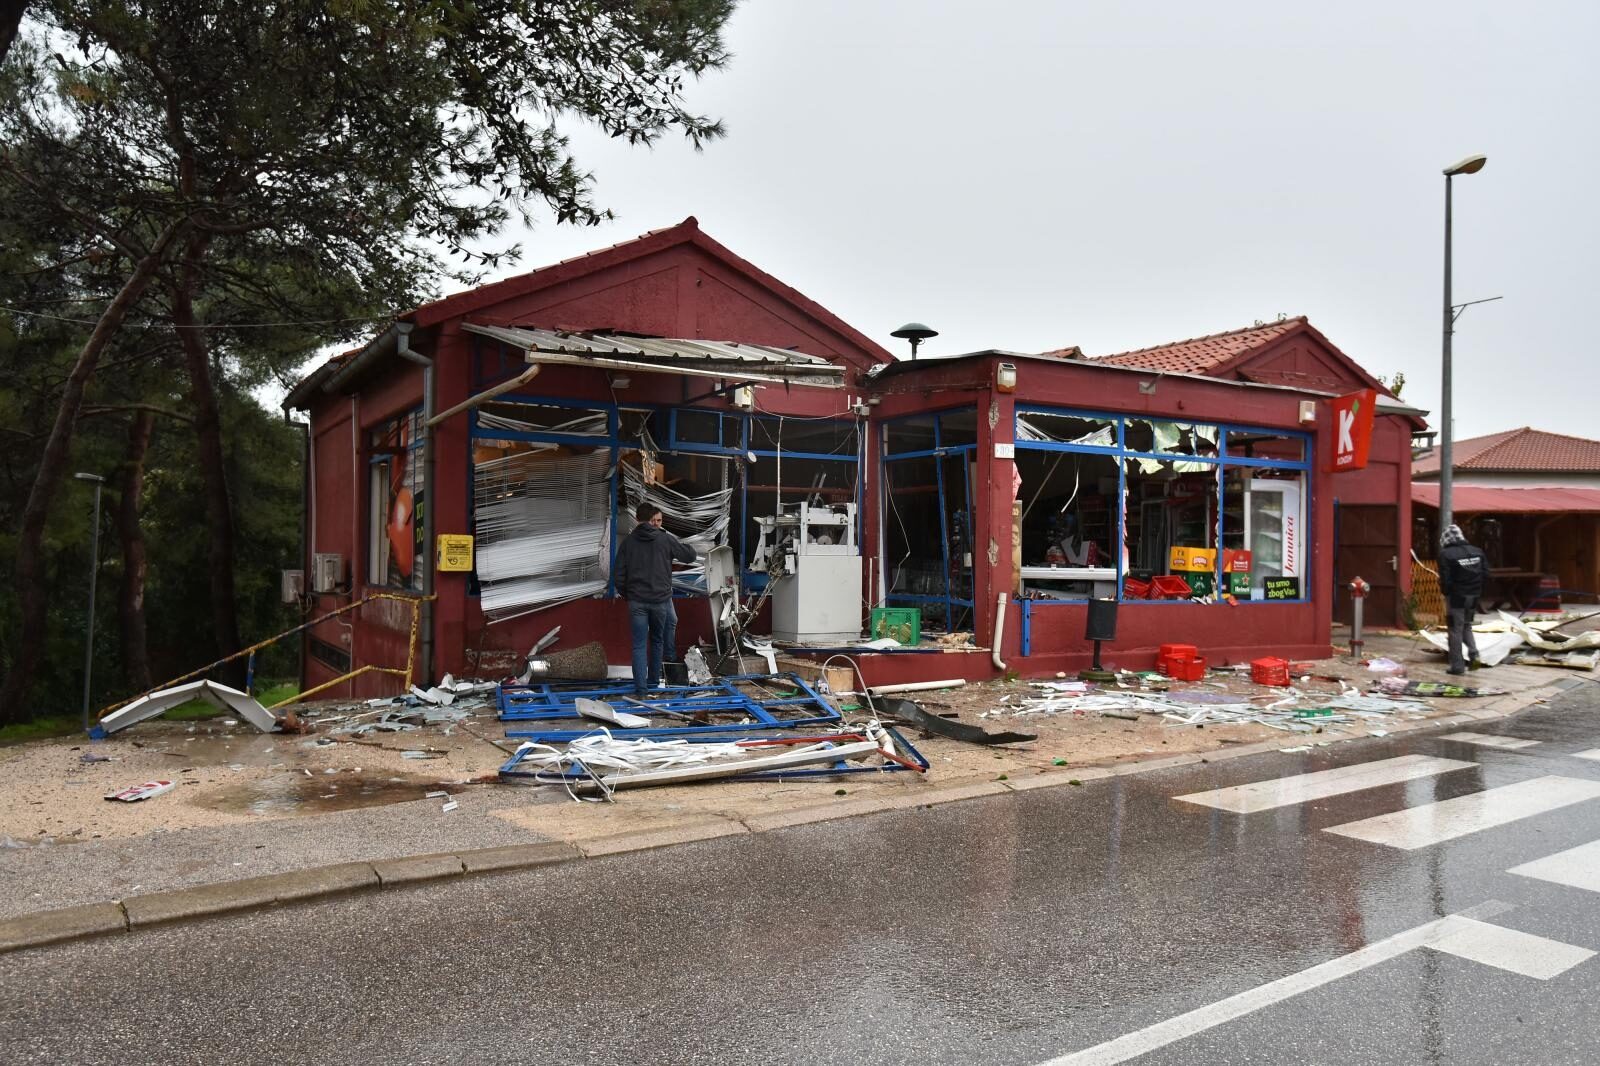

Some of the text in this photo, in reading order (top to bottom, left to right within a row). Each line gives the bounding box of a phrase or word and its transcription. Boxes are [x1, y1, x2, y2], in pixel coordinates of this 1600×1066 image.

[1338, 409, 1354, 454] K
[1276, 580, 1290, 588] smo
[1268, 588, 1296, 599] zbog Vas
